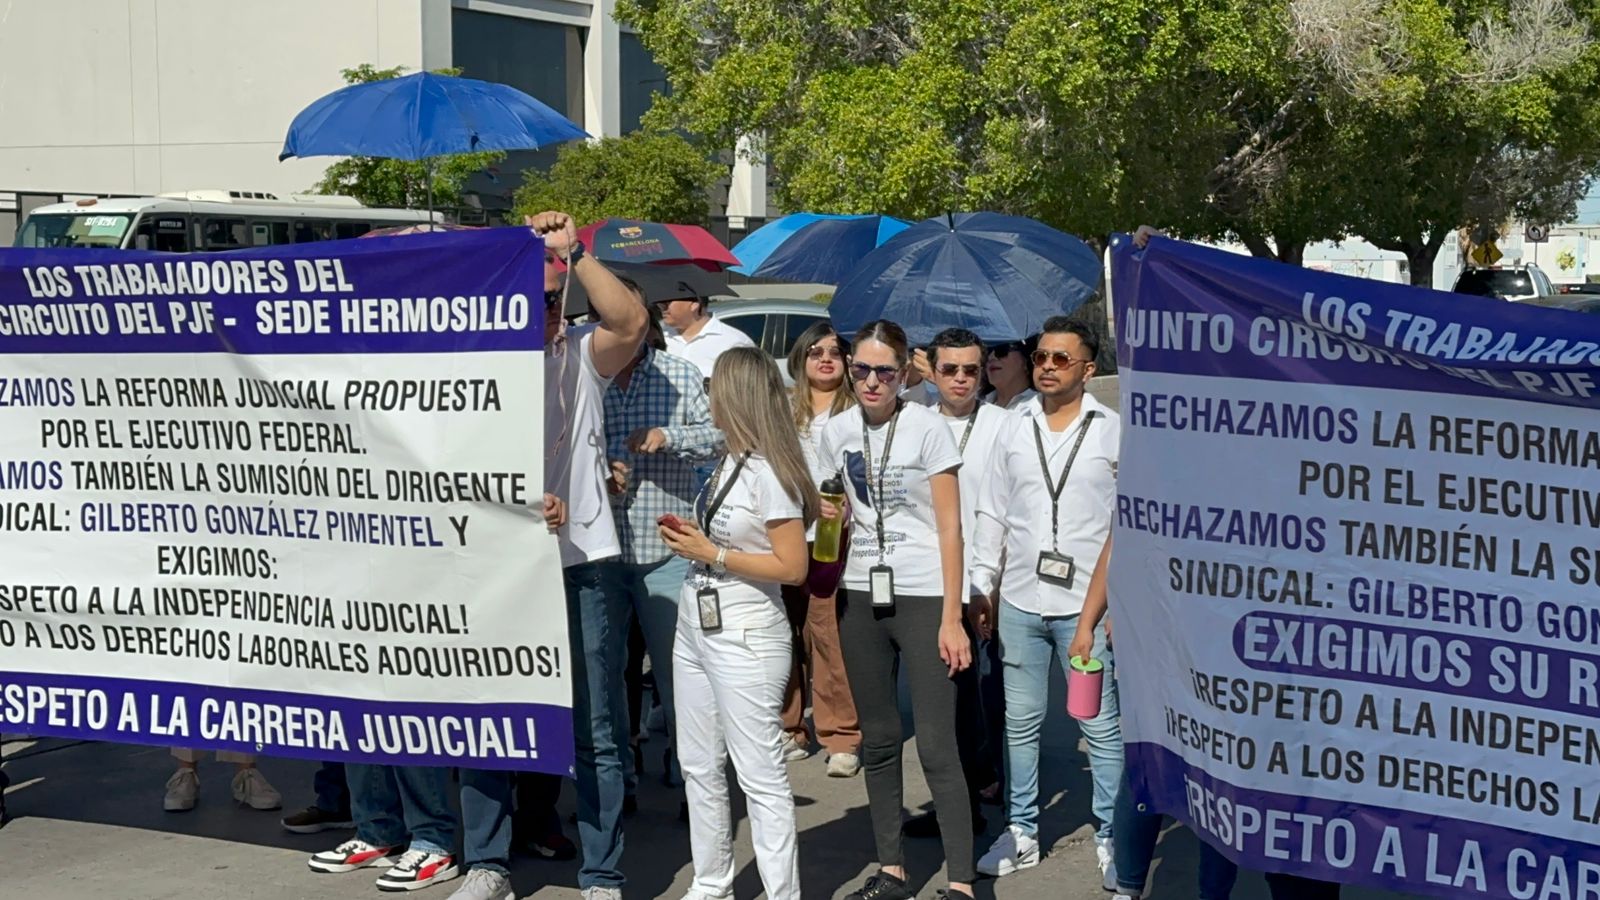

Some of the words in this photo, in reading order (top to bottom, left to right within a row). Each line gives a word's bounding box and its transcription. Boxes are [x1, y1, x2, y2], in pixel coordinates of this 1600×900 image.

[23, 266, 73, 298] LOS
[74, 260, 288, 296] TRABAJADORES
[294, 258, 354, 293] DEL
[0, 302, 110, 336] CIRCUITO
[115, 302, 166, 335] DEL
[168, 301, 215, 334] PJF
[256, 300, 331, 335] SEDE
[340, 294, 529, 333] HERMOSILLO
[1302, 292, 1372, 341] LOS
[81, 378, 111, 407] LA
[115, 378, 228, 408] REFORMA
[235, 378, 336, 411] JUDICIAL
[344, 379, 501, 412] PROPUESTA
[1513, 370, 1597, 398] PJF
[41, 419, 89, 448] POR
[95, 419, 123, 449] EL
[127, 419, 252, 450] EJECUTIVO
[259, 421, 367, 454] FEDERAL.
[1130, 392, 1358, 444] RECHAZAMOS
[1372, 410, 1416, 450] LA
[1429, 415, 1600, 470] REFORMA
[71, 454, 175, 491] TAMBIÉN
[180, 462, 211, 492] LA
[216, 458, 330, 497] SUMISIÓN
[336, 467, 379, 500] DEL
[386, 469, 527, 505] DIRIGENTE
[1299, 460, 1370, 502] POR
[1384, 468, 1425, 507] EL
[80, 502, 197, 534] GILBERTO
[206, 500, 320, 539] GONZÁLEZ
[327, 510, 443, 547] PIMENTEL
[449, 515, 469, 546] Y
[1117, 494, 1326, 554] RECHAZAMOS
[1339, 520, 1497, 573] TAMBIÉN
[1511, 538, 1555, 581] LA
[157, 545, 278, 580] EXIGIMOS:
[88, 586, 104, 615] A
[113, 587, 145, 616] LA
[153, 588, 335, 629] INDEPENDENCIA
[341, 600, 469, 635] JUDICIAL!
[1168, 557, 1333, 609] SINDICAL:
[1348, 576, 1523, 633] GILBERTO
[25, 621, 42, 648] A
[45, 623, 96, 651] LOS
[102, 625, 231, 661] DERECHOS
[238, 633, 369, 674] LABORALES
[378, 645, 561, 679] ADQUIRIDOS!
[1244, 615, 1471, 688] EXIGIMOS
[1488, 646, 1549, 699] SU
[117, 692, 139, 732] A
[150, 694, 189, 737] LA
[200, 698, 349, 751] CARRERA
[358, 713, 538, 759] JUDICIAL!
[1190, 668, 1343, 725] ¡RESPETO
[1355, 693, 1379, 730] A
[1392, 698, 1436, 738] LA
[1267, 741, 1289, 775] A
[1301, 744, 1364, 784] LOS
[1378, 754, 1560, 816] DERECHOS
[1183, 773, 1356, 869] ¡RESPETO
[1372, 825, 1407, 877] A
[1425, 832, 1487, 892] LA
